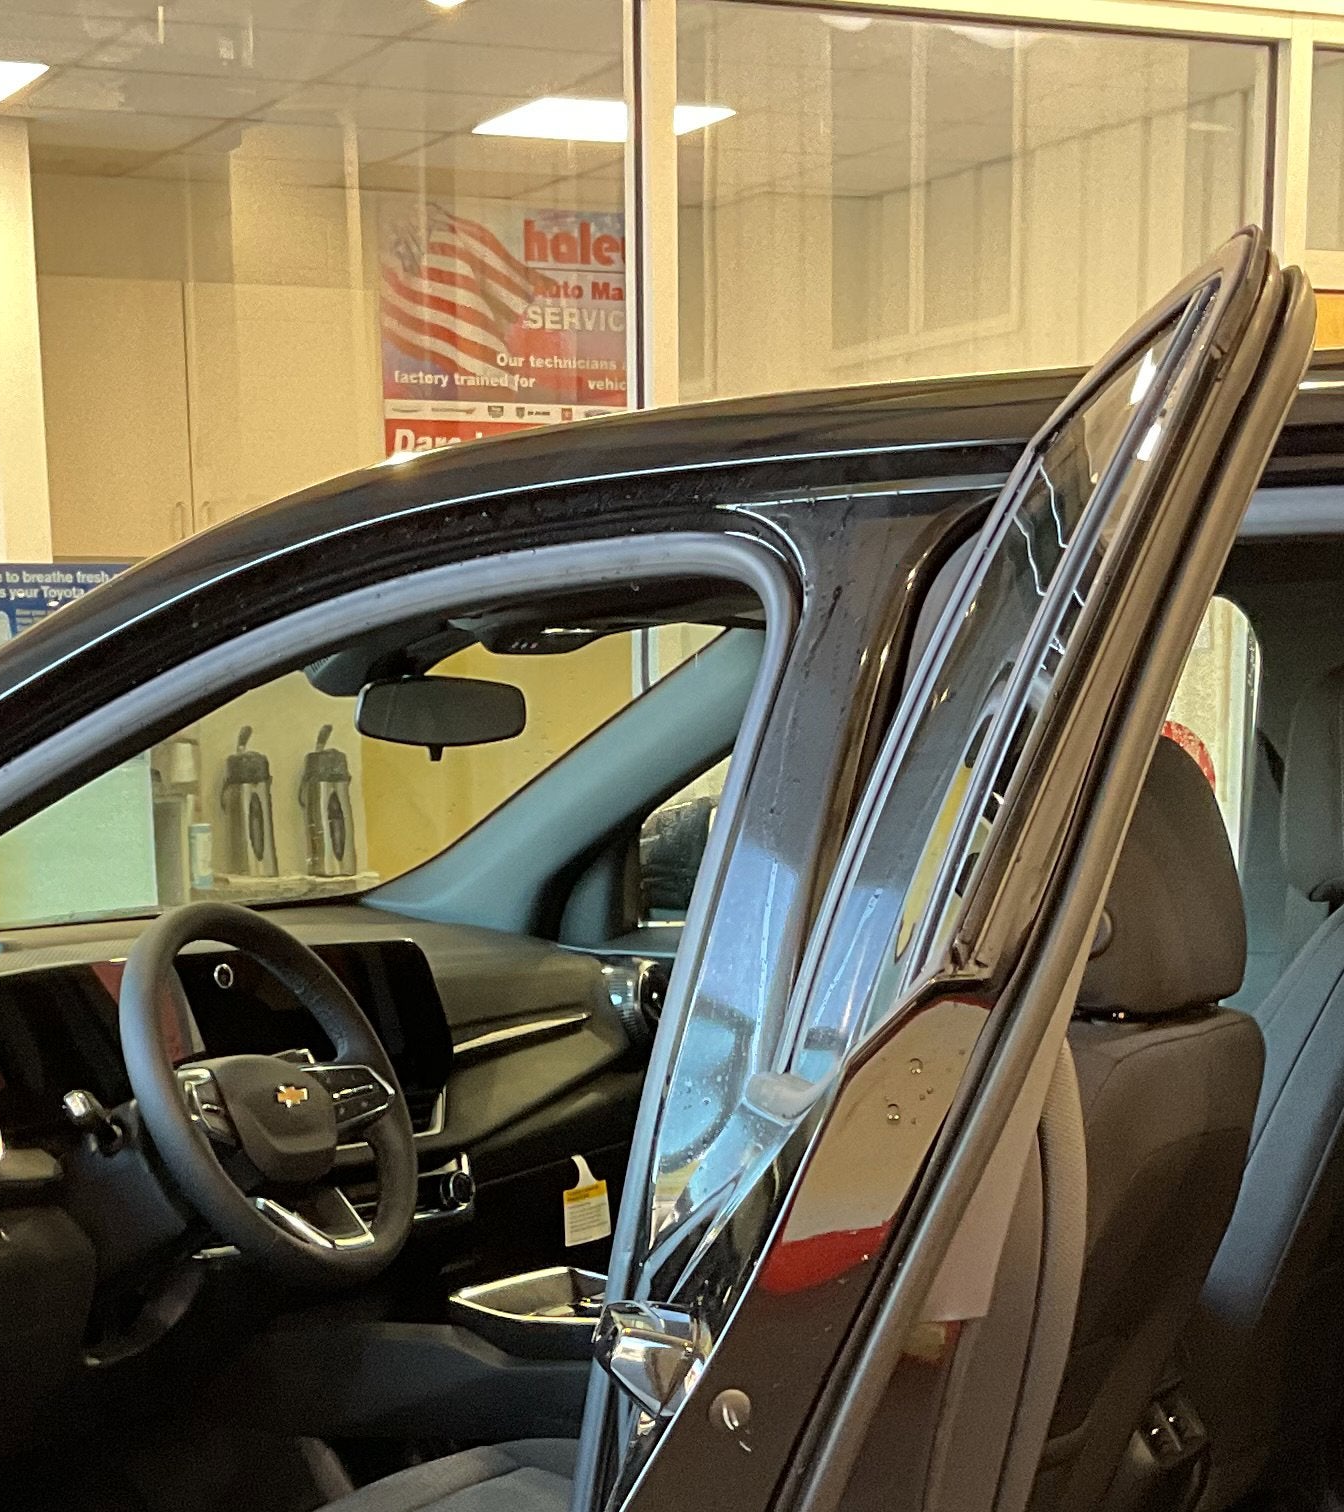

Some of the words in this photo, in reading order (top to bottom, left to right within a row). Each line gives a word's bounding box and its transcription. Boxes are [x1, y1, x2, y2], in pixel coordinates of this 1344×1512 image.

[523, 218, 625, 267] hale
[527, 304, 625, 333] SERVIC
[496, 353, 525, 368] Our
[529, 355, 617, 371] technicians
[394, 370, 449, 387] factory
[454, 373, 509, 388] trained
[513, 374, 536, 389] for
[6, 571, 20, 584] to
[22, 571, 73, 584] breathe
[76, 571, 110, 584] fresh
[9, 588, 39, 601] your
[40, 585, 85, 601] Toyota
